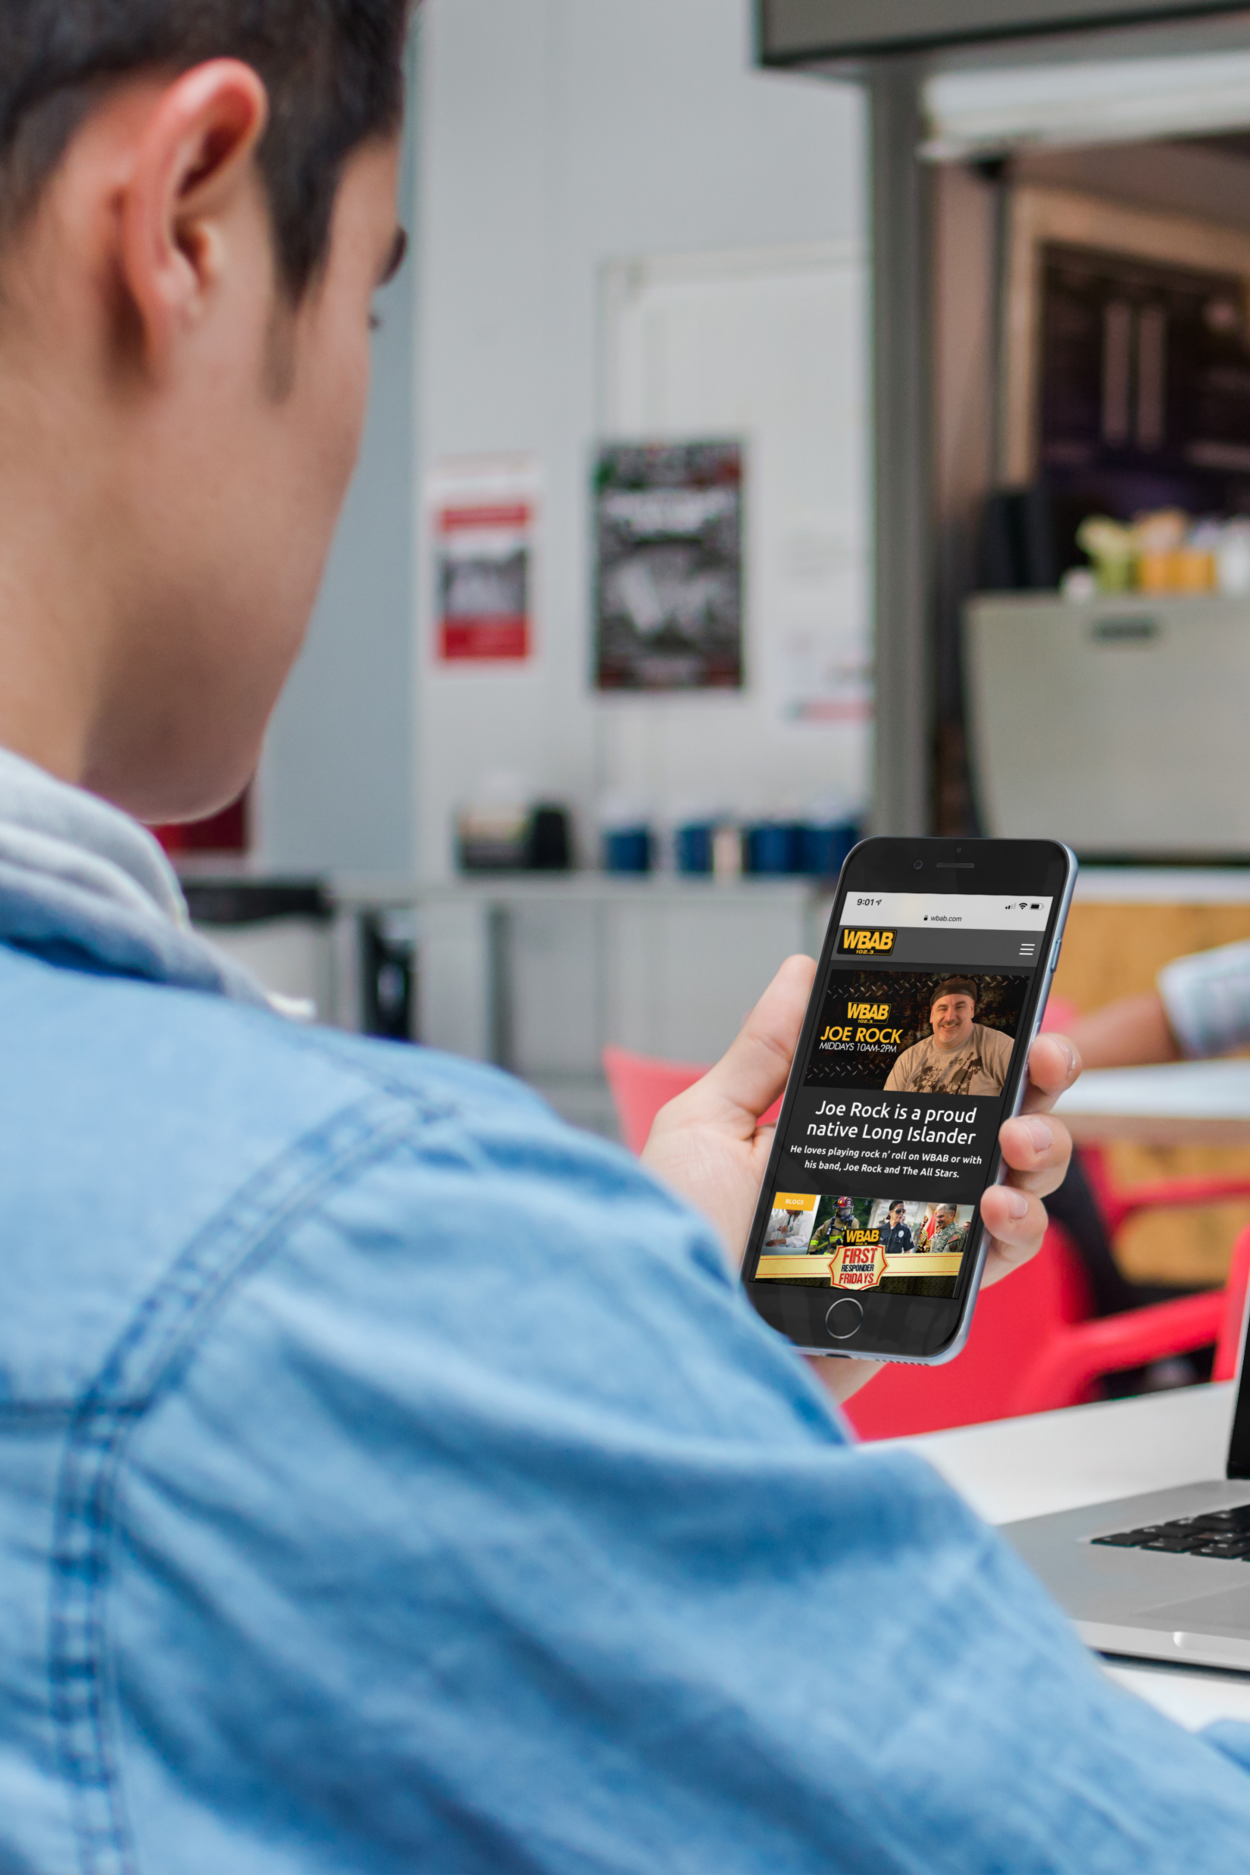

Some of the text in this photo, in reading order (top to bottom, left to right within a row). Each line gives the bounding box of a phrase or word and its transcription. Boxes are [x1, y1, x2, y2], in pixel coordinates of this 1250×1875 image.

[856, 898, 875, 907] 9:01
[930, 915, 962, 923] wbab.com
[842, 929, 894, 950] WBAB
[847, 1002, 889, 1020] WBAB
[820, 1026, 903, 1043] JOE ROCK
[819, 1042, 896, 1053] MIDDAYS 10AM-2PM
[815, 1100, 977, 1124] Joe Rock is a proud
[807, 1122, 976, 1145] native Long Islander
[790, 1144, 801, 1153] He
[804, 1145, 826, 1155] loves
[827, 1147, 859, 1160] playing
[861, 1149, 880, 1159] rock
[891, 1150, 907, 1160] roll
[909, 1153, 920, 1161] on
[922, 1152, 949, 1162] WBAB
[951, 1155, 961, 1163] or
[962, 1155, 982, 1164] with
[846, 1230, 879, 1242] WBAB
[842, 1248, 877, 1264] FIRST
[841, 1264, 874, 1272] RESPONDER
[839, 1273, 874, 1284] FRIDAYS
